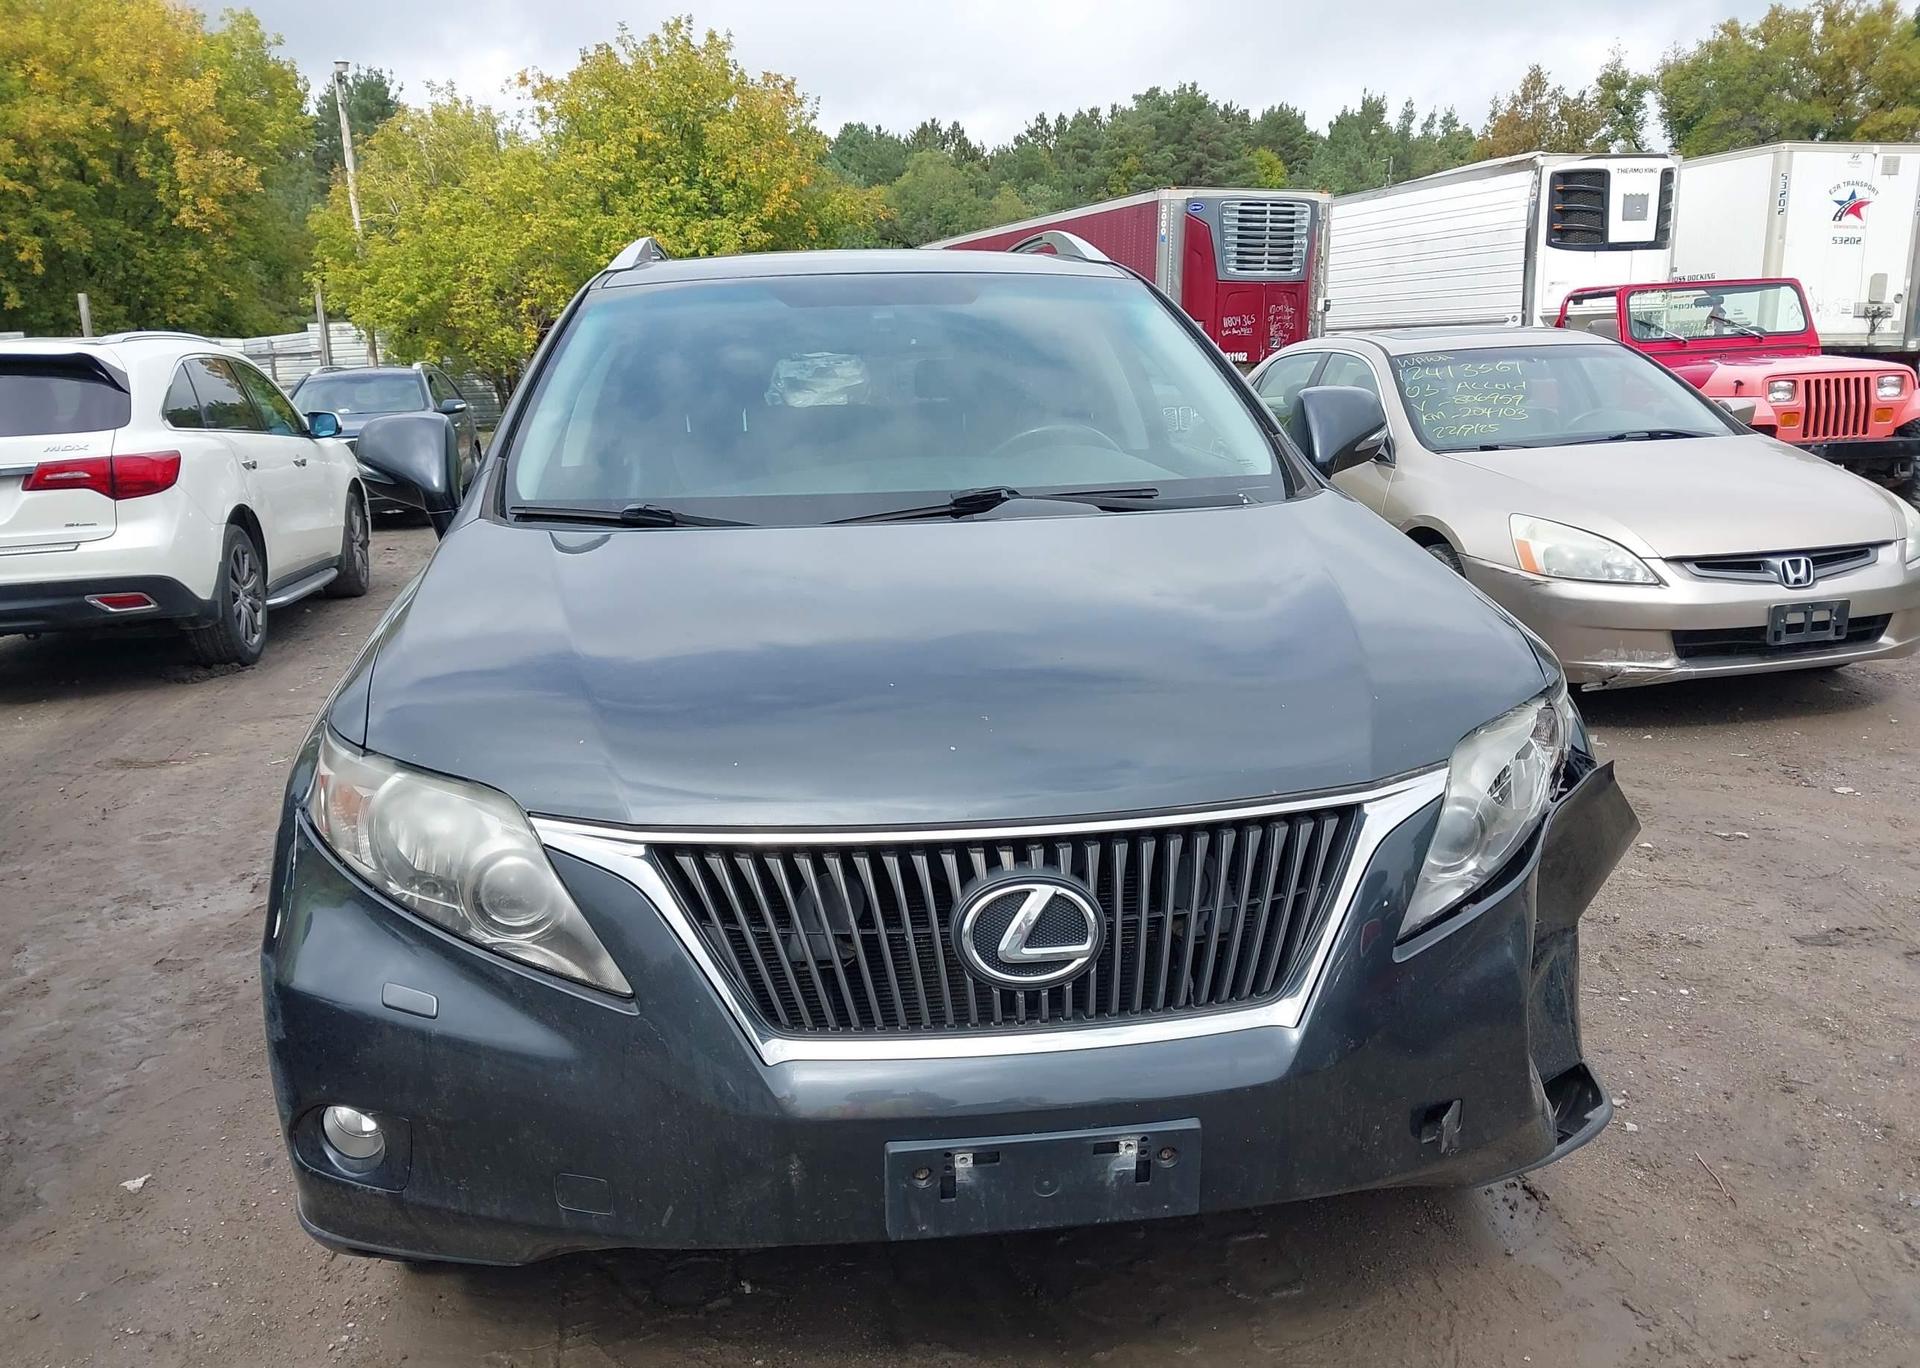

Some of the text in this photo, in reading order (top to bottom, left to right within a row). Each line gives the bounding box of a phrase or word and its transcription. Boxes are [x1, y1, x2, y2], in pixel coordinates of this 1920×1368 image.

[1842, 180, 1880, 197] TRANSPORT
[1777, 172, 1788, 216] 53202
[1831, 236, 1862, 245] 53202
[1687, 272, 1716, 281] DOCKING
[43, 444, 89, 453] MDX
